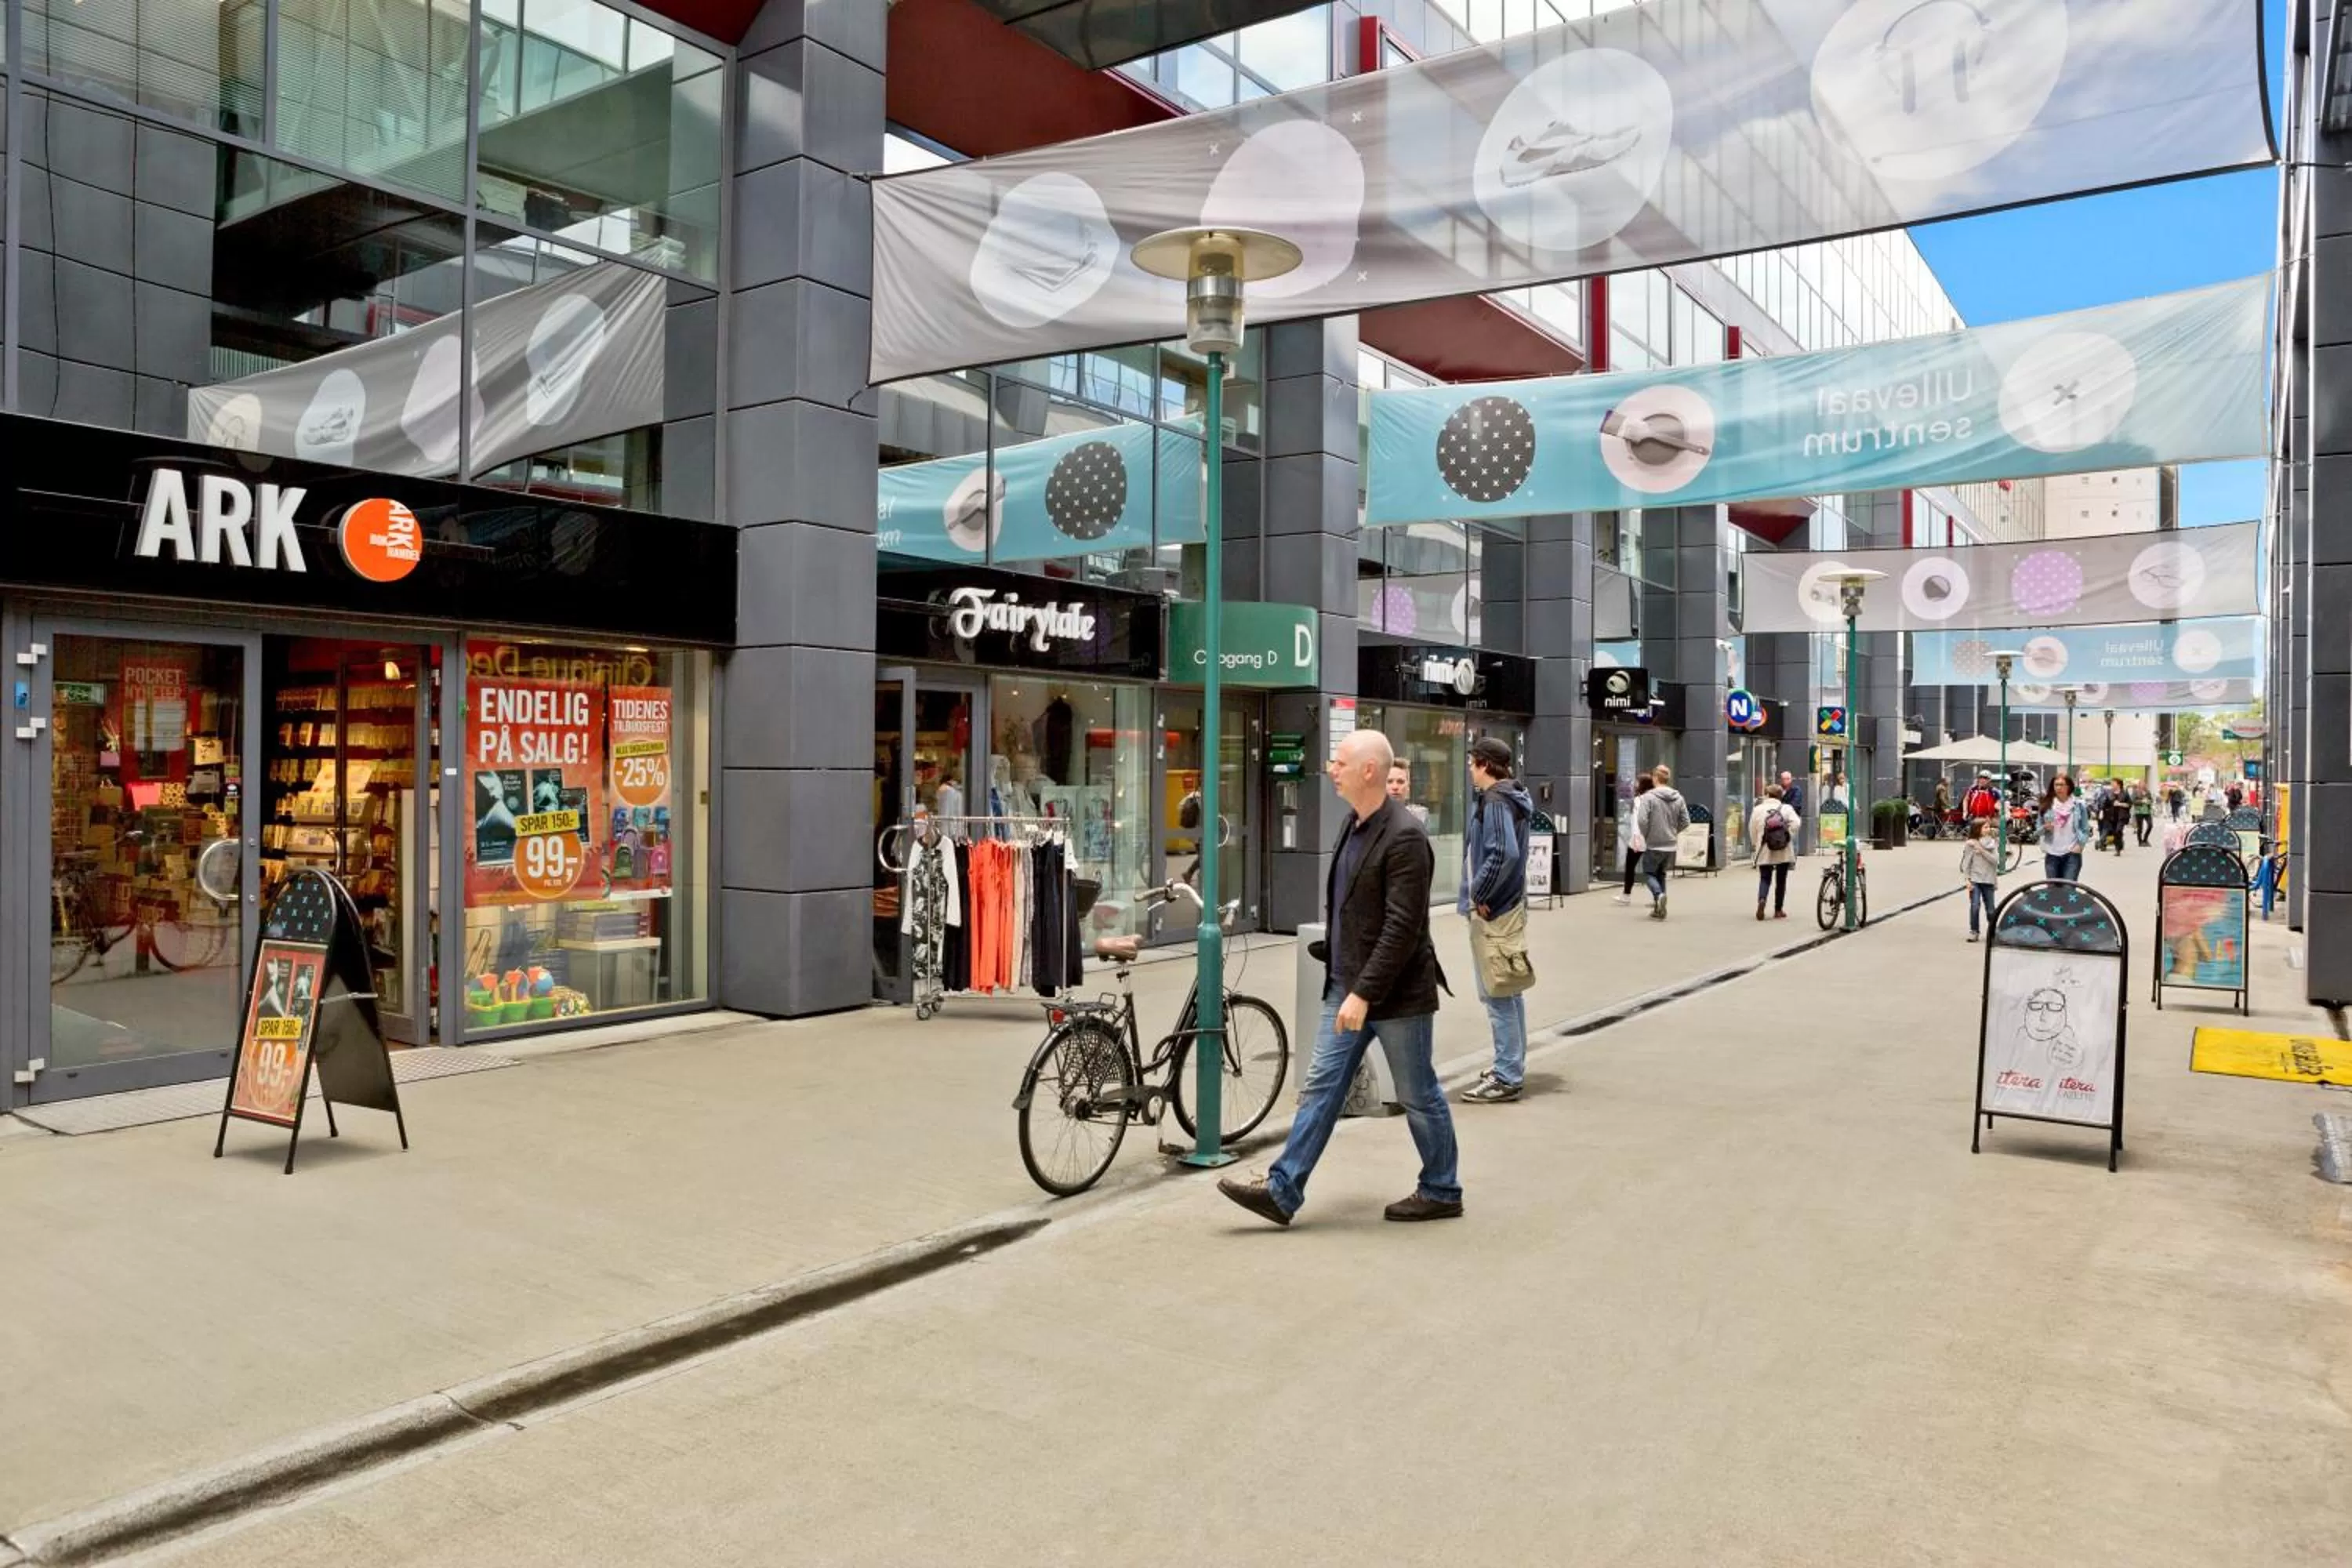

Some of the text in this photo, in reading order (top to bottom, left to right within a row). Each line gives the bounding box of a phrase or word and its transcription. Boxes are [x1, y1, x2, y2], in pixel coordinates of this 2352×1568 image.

[134, 468, 307, 573] ARK
[388, 499, 415, 551] ARK
[949, 587, 1096, 652] Fairytale
[1267, 650, 1278, 666] D
[1294, 623, 1312, 667] D
[125, 666, 183, 685] POCKET
[480, 687, 589, 726] ENDELIG
[612, 698, 669, 720] TIDENES
[1604, 695, 1631, 708] nimi
[1730, 699, 1748, 717] N
[479, 724, 514, 764] PÅ
[615, 758, 665, 787] -25%
[520, 815, 548, 833] SPAR
[526, 835, 578, 882] 99,-
